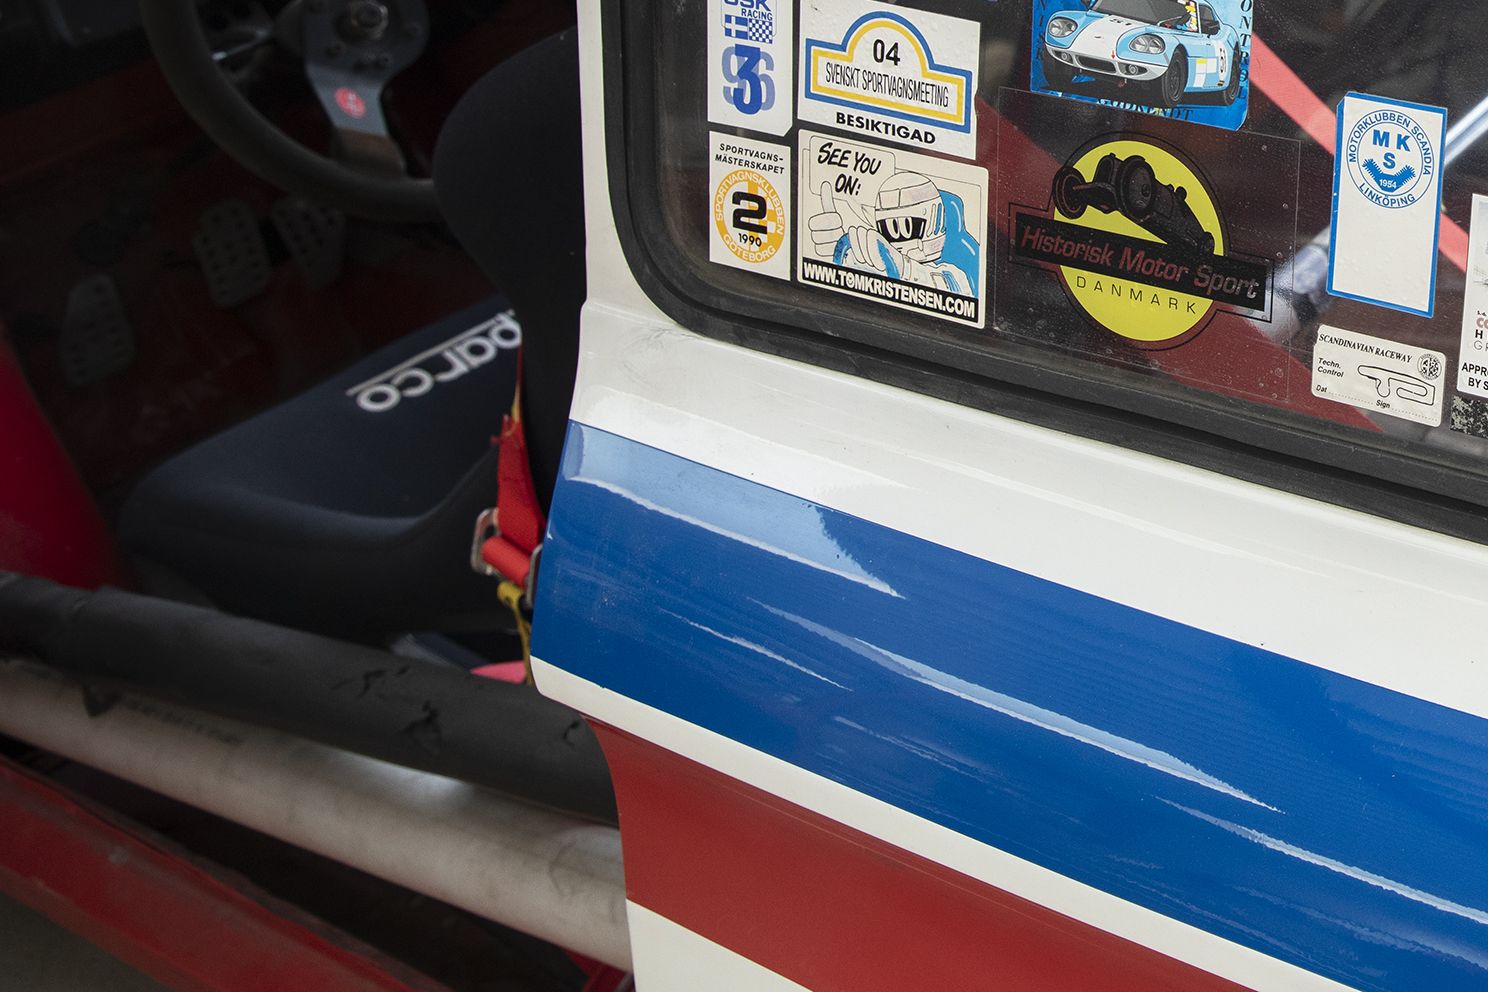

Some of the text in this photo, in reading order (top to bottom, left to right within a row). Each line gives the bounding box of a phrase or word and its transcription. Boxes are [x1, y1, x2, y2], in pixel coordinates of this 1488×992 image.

[741, 8, 773, 21] RACING
[872, 39, 901, 66] 04
[825, 61, 949, 108] SVENSKT SPORTVAGNSMEETING
[836, 112, 936, 144] BESIKTIGAD
[719, 143, 784, 162] SPORTVAGNS-
[1348, 111, 1432, 176] MOTORKLUBBEN SCANDIA
[715, 154, 785, 175] MÄSTERSKAPET
[817, 142, 882, 176] SEE YOU
[1383, 152, 1396, 169] S
[1359, 182, 1416, 207] LINKÖPING
[1379, 179, 1397, 189] 1954
[716, 171, 785, 236] SPORTVAGNSKLUBBEN
[732, 191, 768, 235] 2
[738, 233, 762, 248] 1990
[1021, 224, 1261, 300] Historisk Motor Sport
[803, 261, 976, 319] WWW.TOMKRISTENSEN.COM
[1076, 275, 1196, 314] DANMARK
[356, 309, 522, 413] parco
[1318, 334, 1413, 364] SCANDINAVIAN RACEWAY
[1317, 366, 1344, 378] Control
[1318, 357, 1341, 369] Techn.
[1468, 377, 1482, 388] BY
[1375, 399, 1391, 409] Sign
